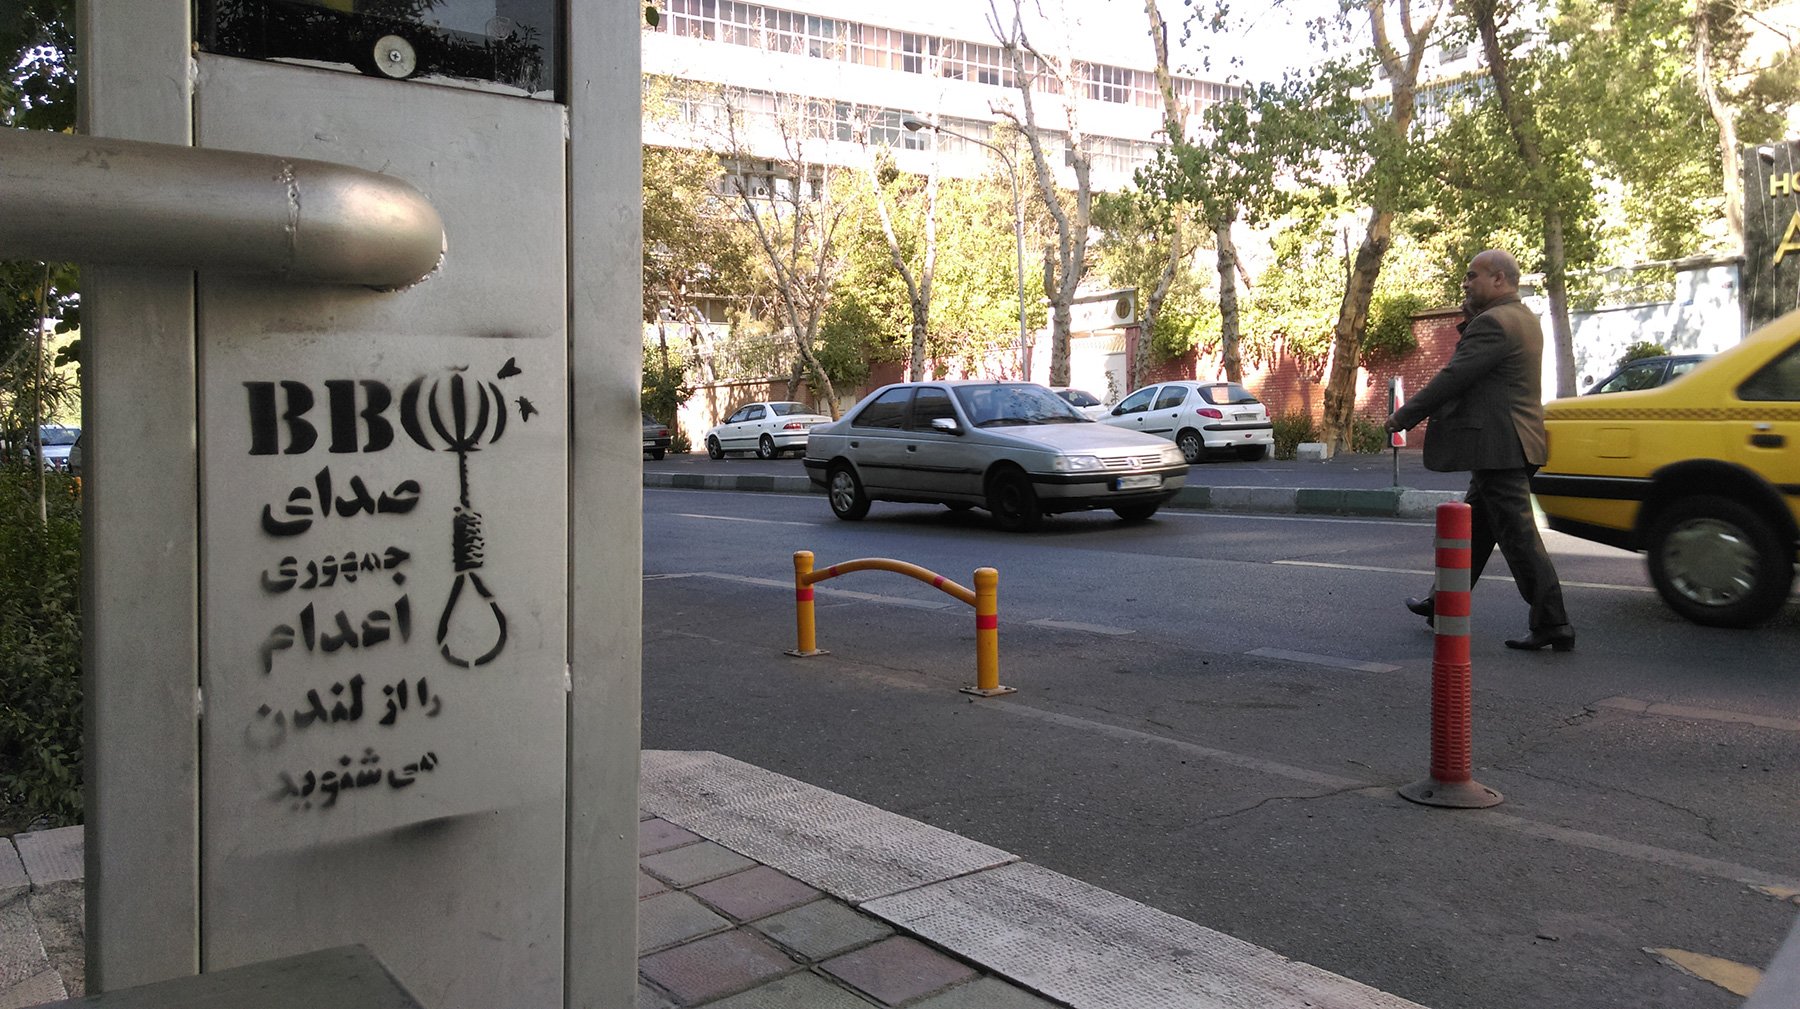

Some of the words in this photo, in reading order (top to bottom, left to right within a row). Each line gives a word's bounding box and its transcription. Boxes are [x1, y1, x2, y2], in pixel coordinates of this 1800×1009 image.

[262, 465, 421, 536] صدای
[262, 593, 411, 674] اعدام
[244, 673, 365, 750] لندن
[379, 678, 408, 725] از
[417, 676, 441, 718] را
